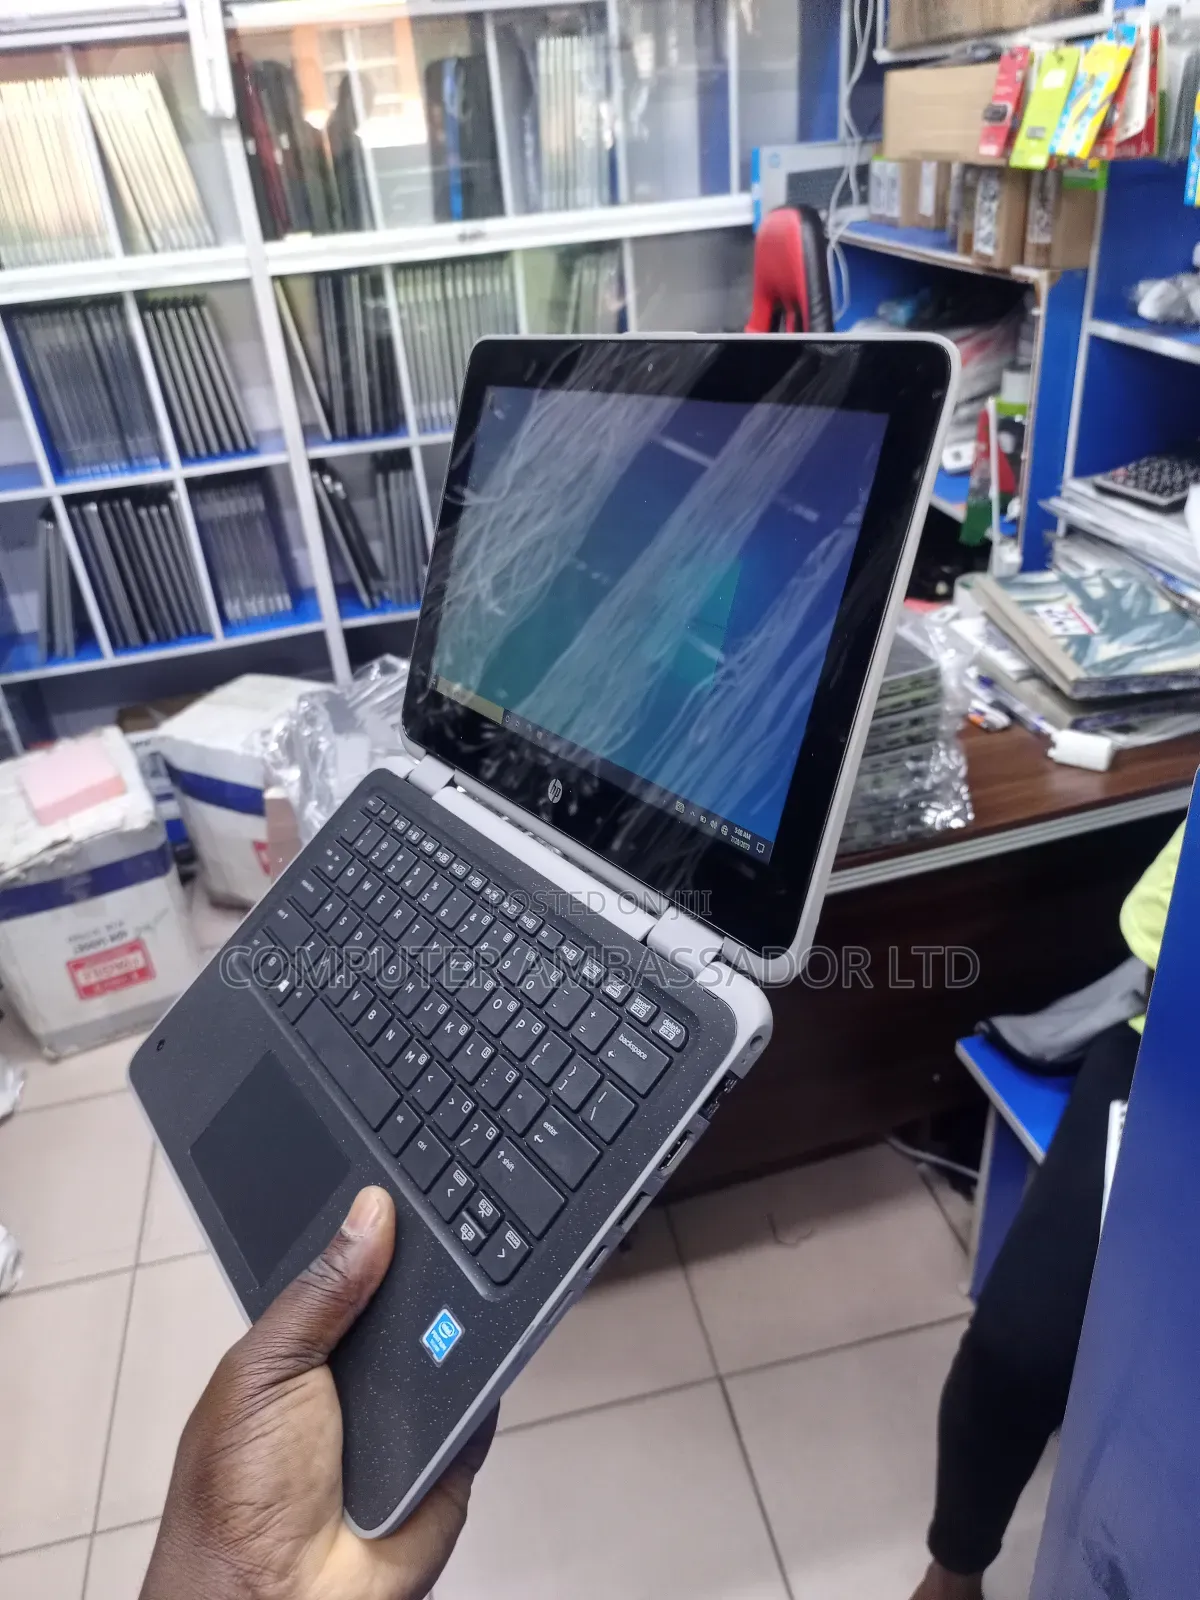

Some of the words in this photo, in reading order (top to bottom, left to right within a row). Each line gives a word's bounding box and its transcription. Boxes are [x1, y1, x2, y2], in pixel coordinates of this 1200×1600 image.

[548, 779, 562, 803] hp
[347, 868, 355, 877] Q
[362, 880, 372, 891] W
[377, 894, 386, 904] E
[325, 903, 333, 912] A
[393, 909, 402, 919] R
[339, 916, 348, 926] S
[412, 924, 420, 934] T
[354, 931, 363, 941] D
[306, 941, 314, 951] Z
[430, 941, 439, 950] Y
[388, 965, 397, 975] G
[335, 974, 345, 984] C
[405, 982, 415, 994] H
[352, 990, 361, 1001] V
[424, 1002, 434, 1011] J
[493, 998, 503, 1010] O
[634, 996, 651, 1012] insert
[368, 1009, 377, 1020] B
[444, 1022, 455, 1034] K
[515, 1019, 526, 1029] P
[662, 1018, 681, 1035] delete
[386, 1029, 396, 1041] N
[466, 1043, 474, 1055] L
[618, 1033, 648, 1060] backspace
[404, 1051, 415, 1063] M
[543, 1121, 559, 1136] enter
[417, 1140, 427, 1151] ctrl
[502, 1158, 515, 1172] shift
